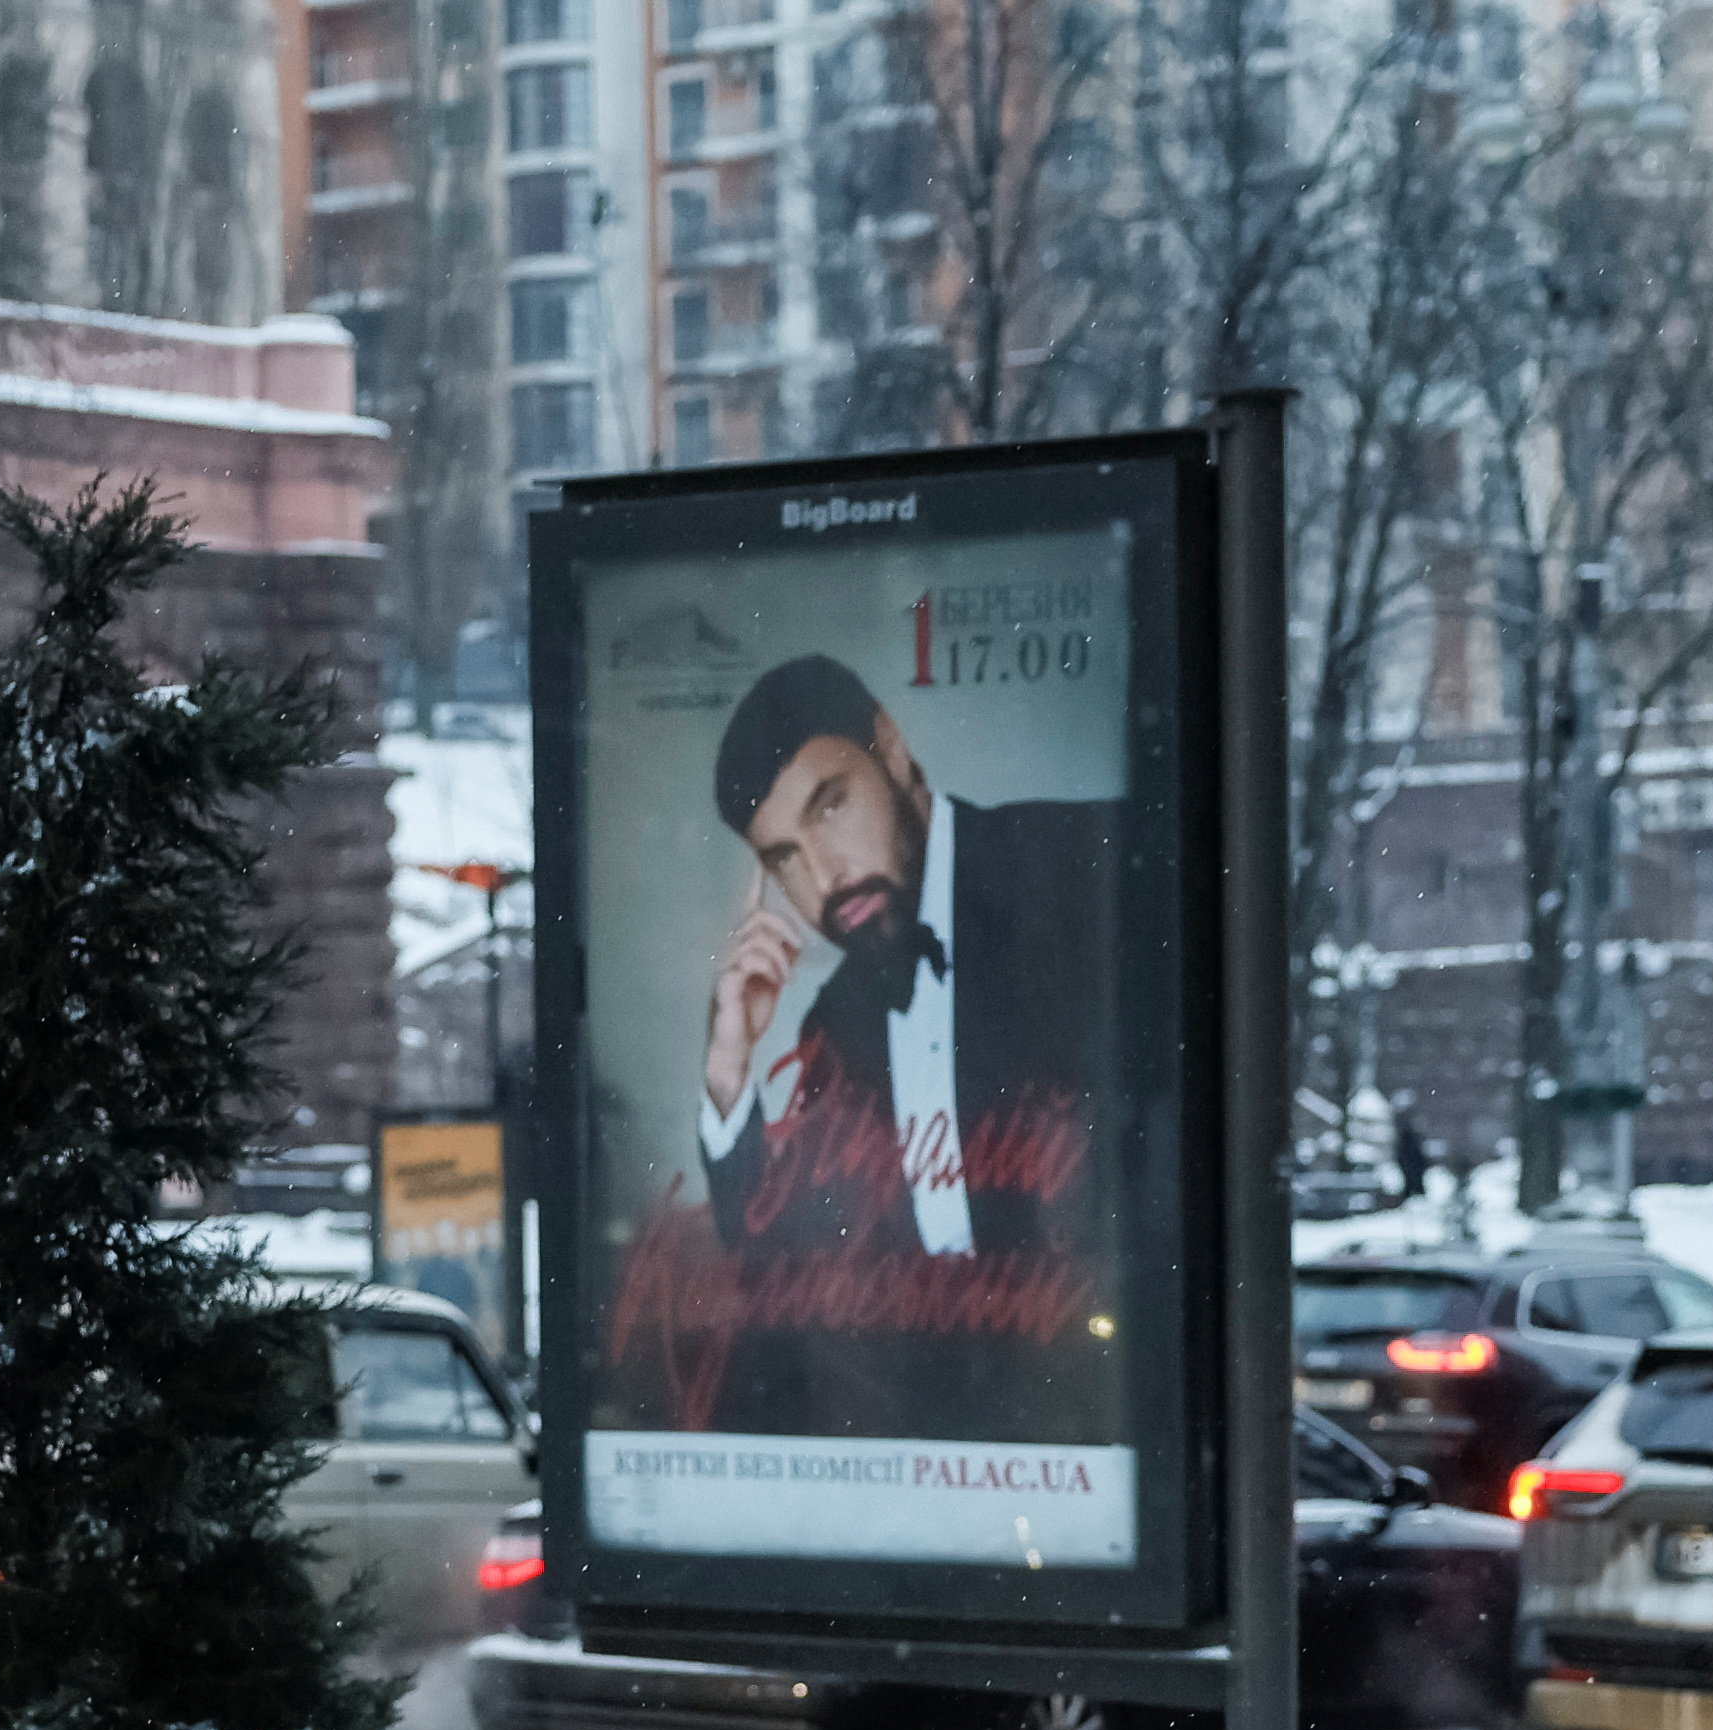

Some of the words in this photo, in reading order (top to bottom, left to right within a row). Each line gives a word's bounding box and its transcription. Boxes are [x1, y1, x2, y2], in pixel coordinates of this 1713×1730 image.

[781, 491, 919, 533] BigBoard
[904, 587, 935, 688] 1
[948, 630, 1090, 685] 17.00
[614, 1450, 728, 1478] КВИТКИ
[734, 1452, 784, 1481] БЕЗ
[912, 1454, 1093, 1494] PALAC.UA
